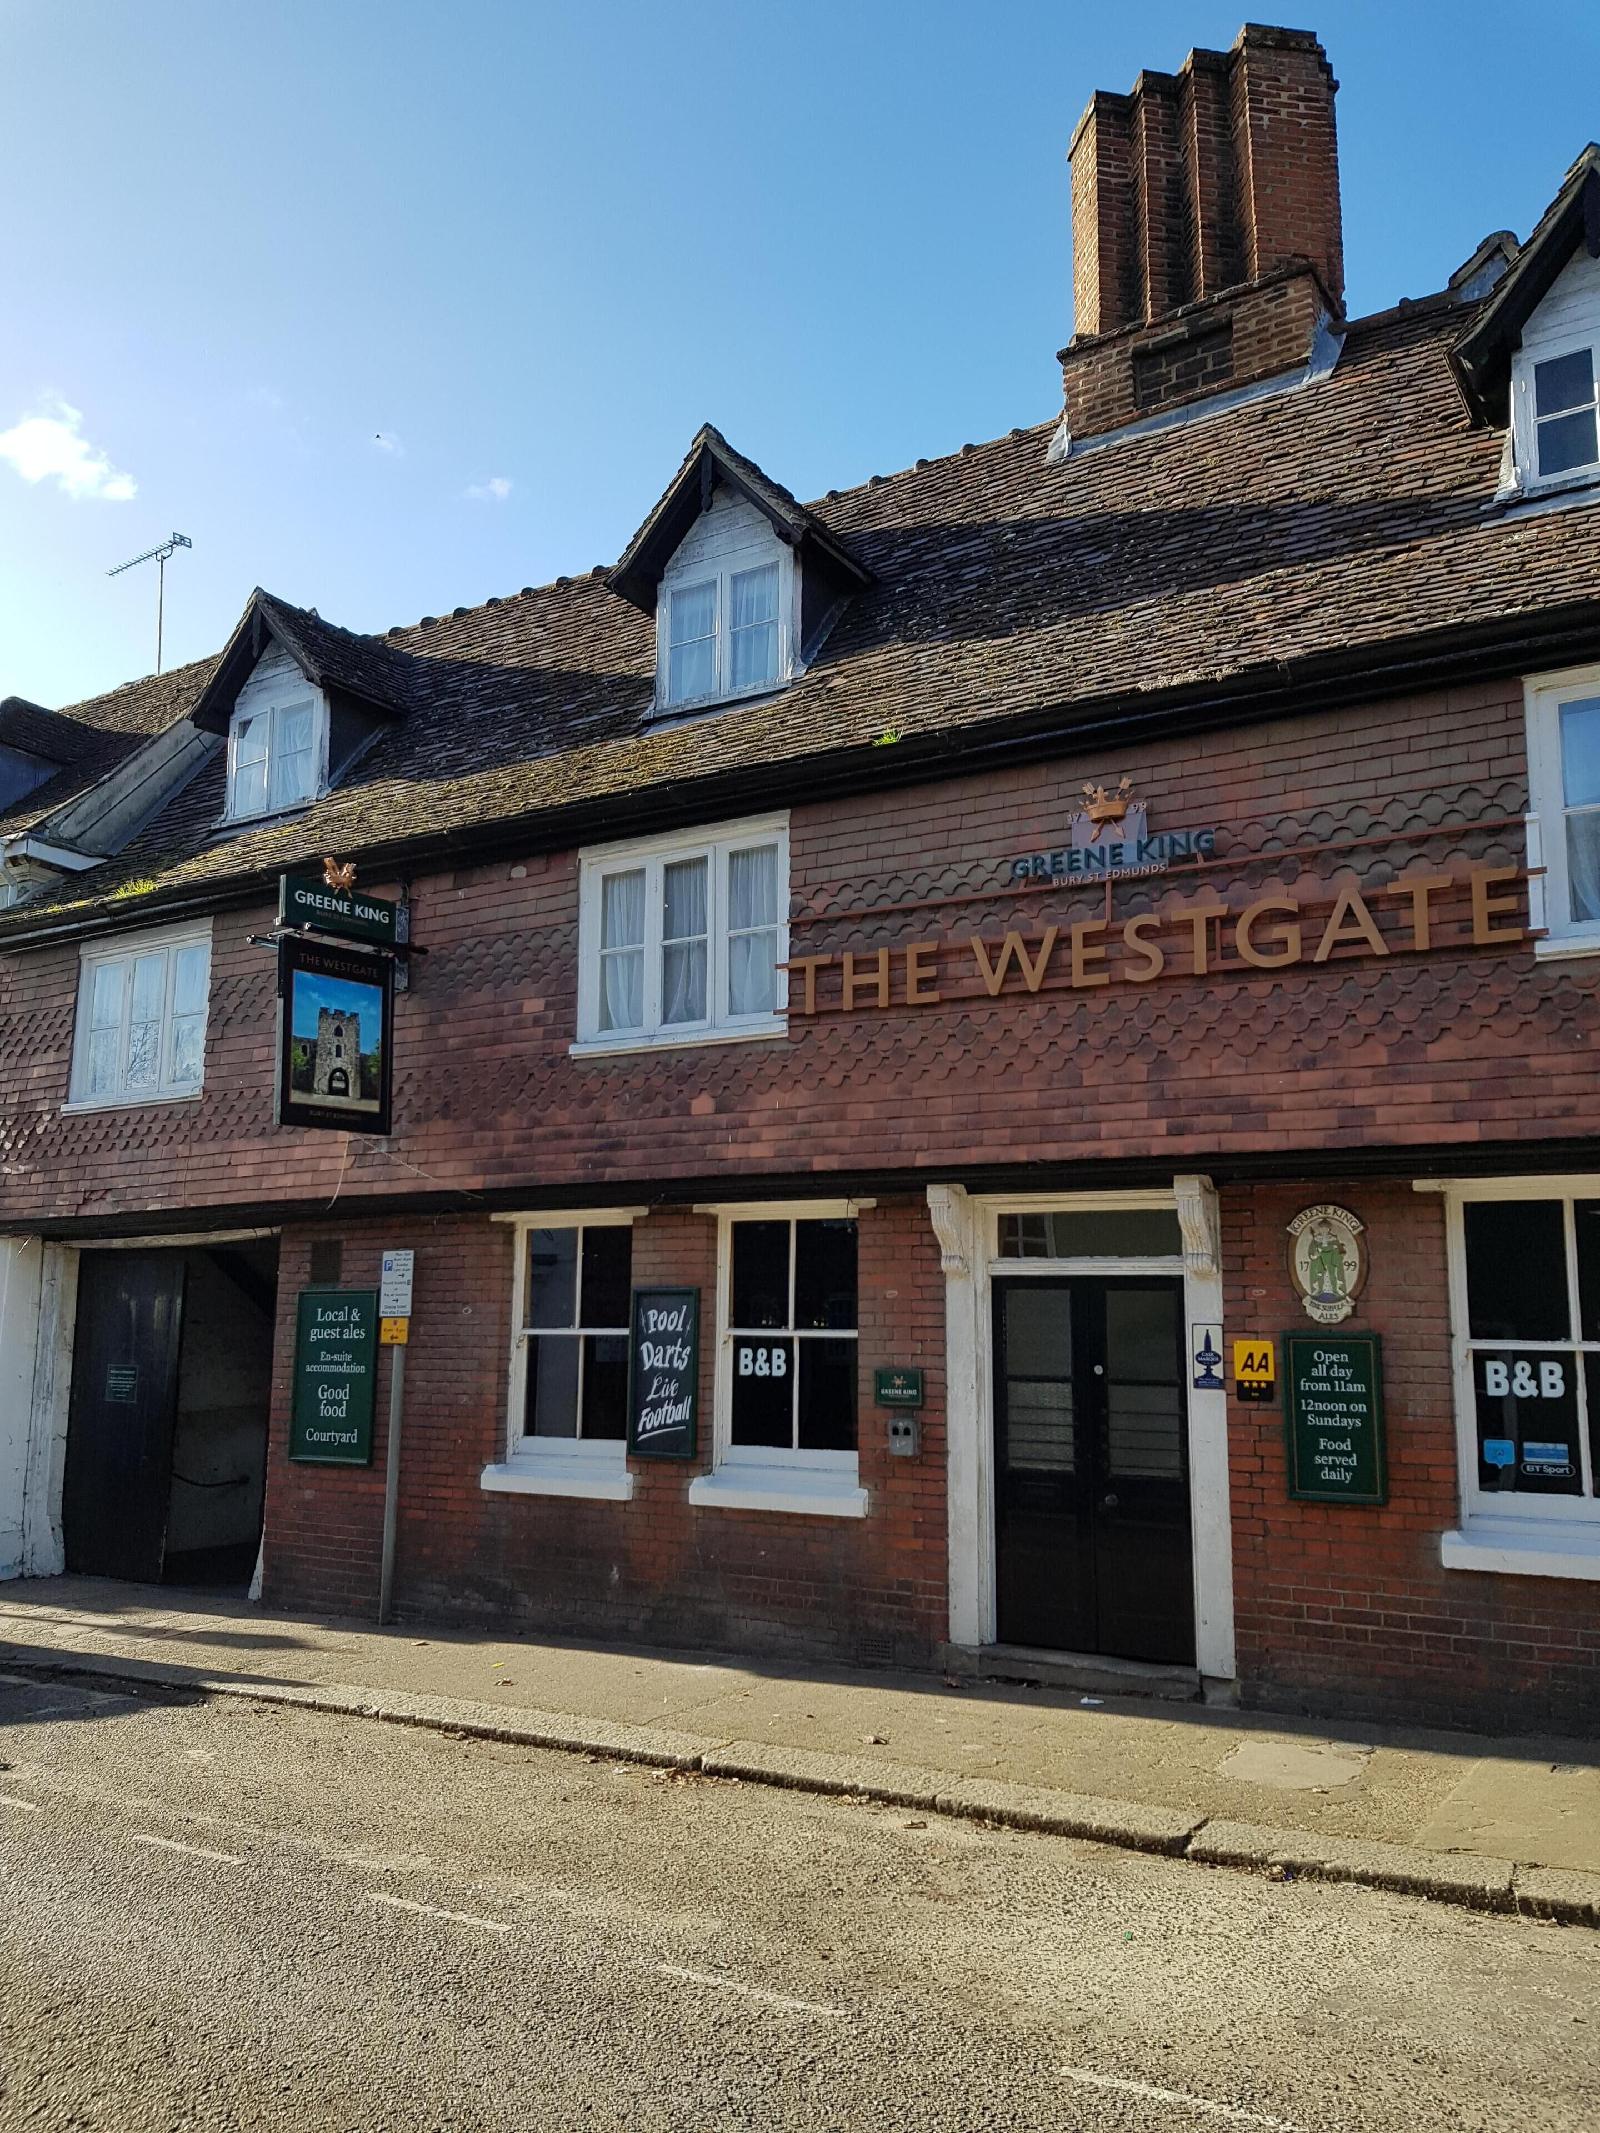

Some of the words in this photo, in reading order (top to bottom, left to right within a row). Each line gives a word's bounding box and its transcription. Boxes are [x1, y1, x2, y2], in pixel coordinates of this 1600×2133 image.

[1010, 842, 1124, 879] GREENE
[1136, 829, 1216, 862] KING
[1052, 873, 1084, 888] BURY
[1088, 871, 1101, 882] ST
[1104, 862, 1169, 880] EDMUNDS
[294, 889, 352, 915] GREENE
[354, 903, 391, 924] KING
[798, 941, 941, 1016] THE
[969, 866, 1526, 996] WESTGATE
[298, 952, 321, 963] THE
[323, 957, 379, 979] WESTGATE
[1292, 1206, 1331, 1231] GREENE
[1332, 1207, 1361, 1232] KING
[1299, 1261, 1310, 1273] 17
[1343, 1260, 1358, 1273] 99
[316, 1306, 348, 1322] Local
[350, 1308, 362, 1322] &
[647, 1304, 688, 1334] Pool
[309, 1326, 341, 1342] guest
[342, 1323, 366, 1340] ales
[320, 1350, 353, 1362] En-suite
[640, 1337, 692, 1371] Darts
[738, 1347, 787, 1377] B&B
[1240, 1351, 1269, 1373] AA
[1313, 1350, 1349, 1366] Open
[305, 1361, 366, 1374] accommodation
[1311, 1364, 1327, 1377] all
[1330, 1364, 1354, 1380] day
[645, 1371, 679, 1402] Live
[1299, 1377, 1332, 1392] from
[1333, 1380, 1367, 1393] 11am
[1485, 1360, 1566, 1399] B&B
[317, 1383, 350, 1401] Good
[319, 1399, 347, 1417] food
[637, 1394, 693, 1433] Football
[1300, 1398, 1348, 1413] 12noon
[1349, 1401, 1368, 1413] on
[1306, 1413, 1362, 1430] Sundays
[305, 1427, 358, 1446] Courtyard
[1318, 1437, 1352, 1451] Food
[1313, 1453, 1358, 1466] served
[1320, 1466, 1353, 1484] daily
[1542, 1464, 1571, 1475] Sport
